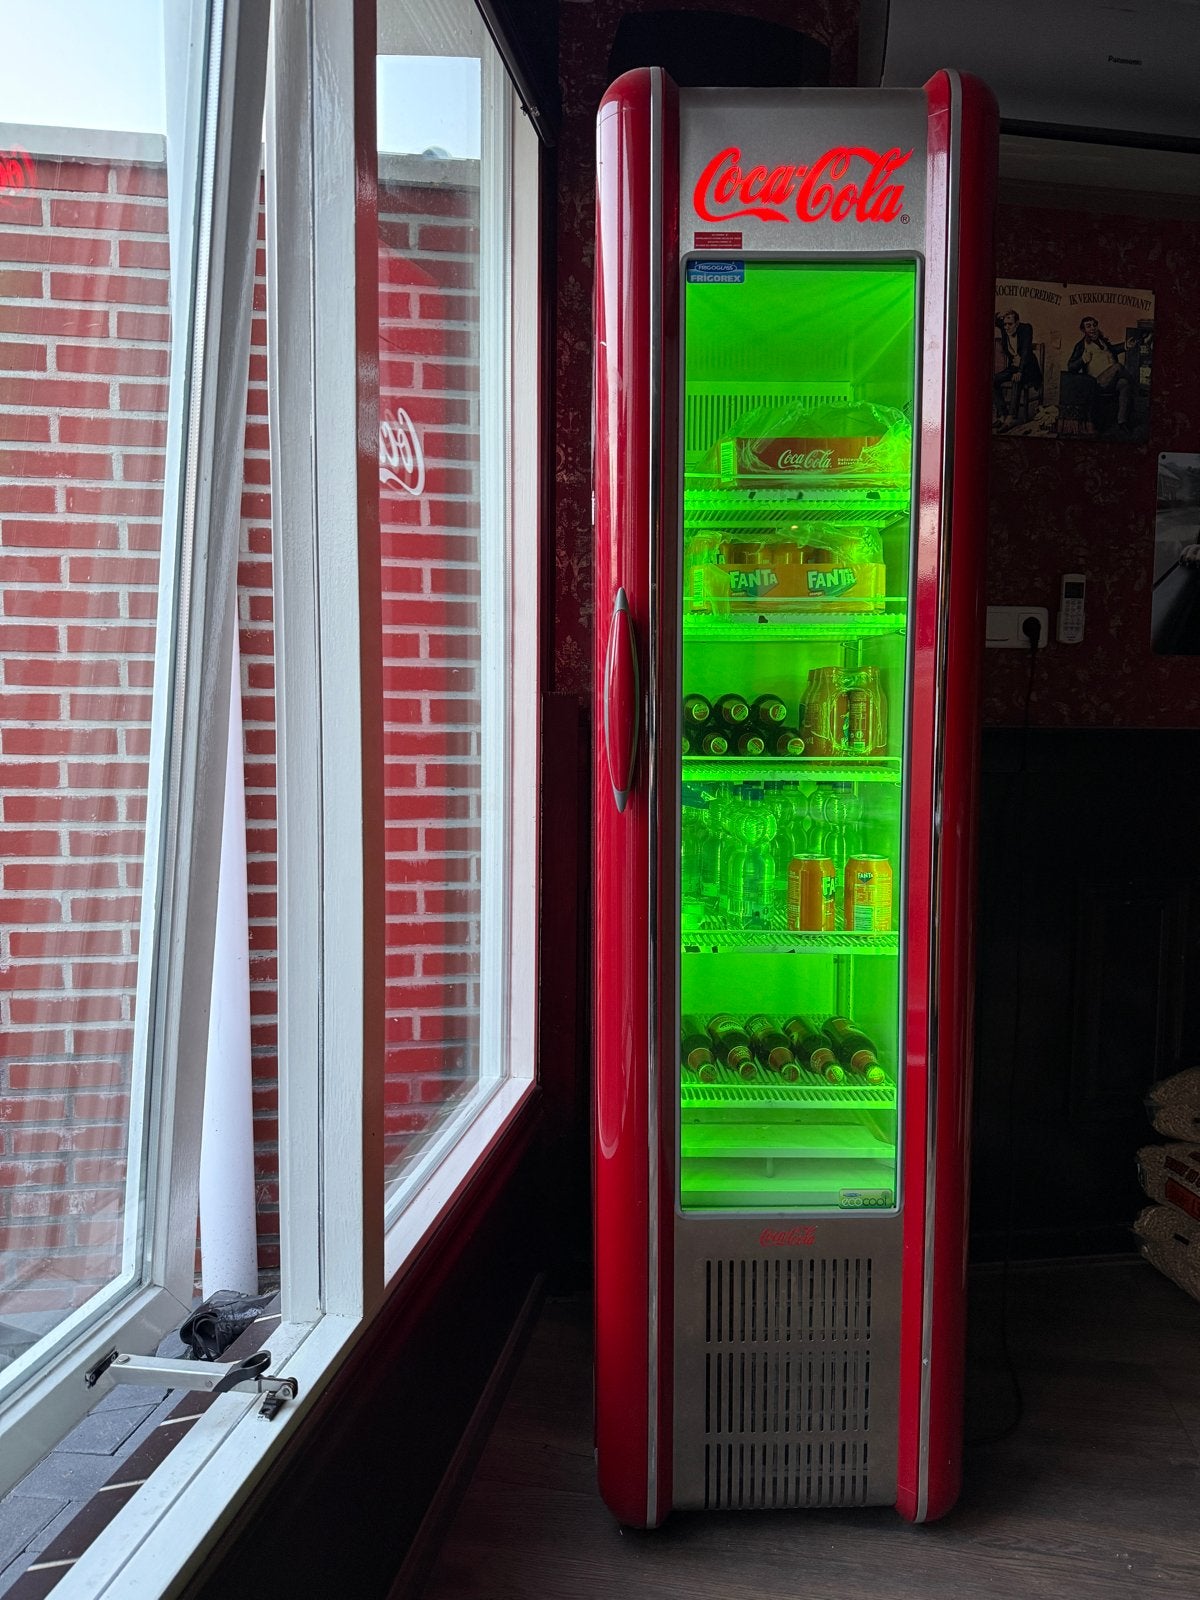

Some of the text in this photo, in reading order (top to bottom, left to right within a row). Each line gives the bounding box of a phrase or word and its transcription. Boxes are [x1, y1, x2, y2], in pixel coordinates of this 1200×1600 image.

[1019, 286, 1030, 297] OP
[1078, 292, 1116, 304] VERKOCHT
[1117, 294, 1152, 312] CONTANT!
[729, 569, 778, 589] FANTA
[808, 568, 856, 589] FANTA
